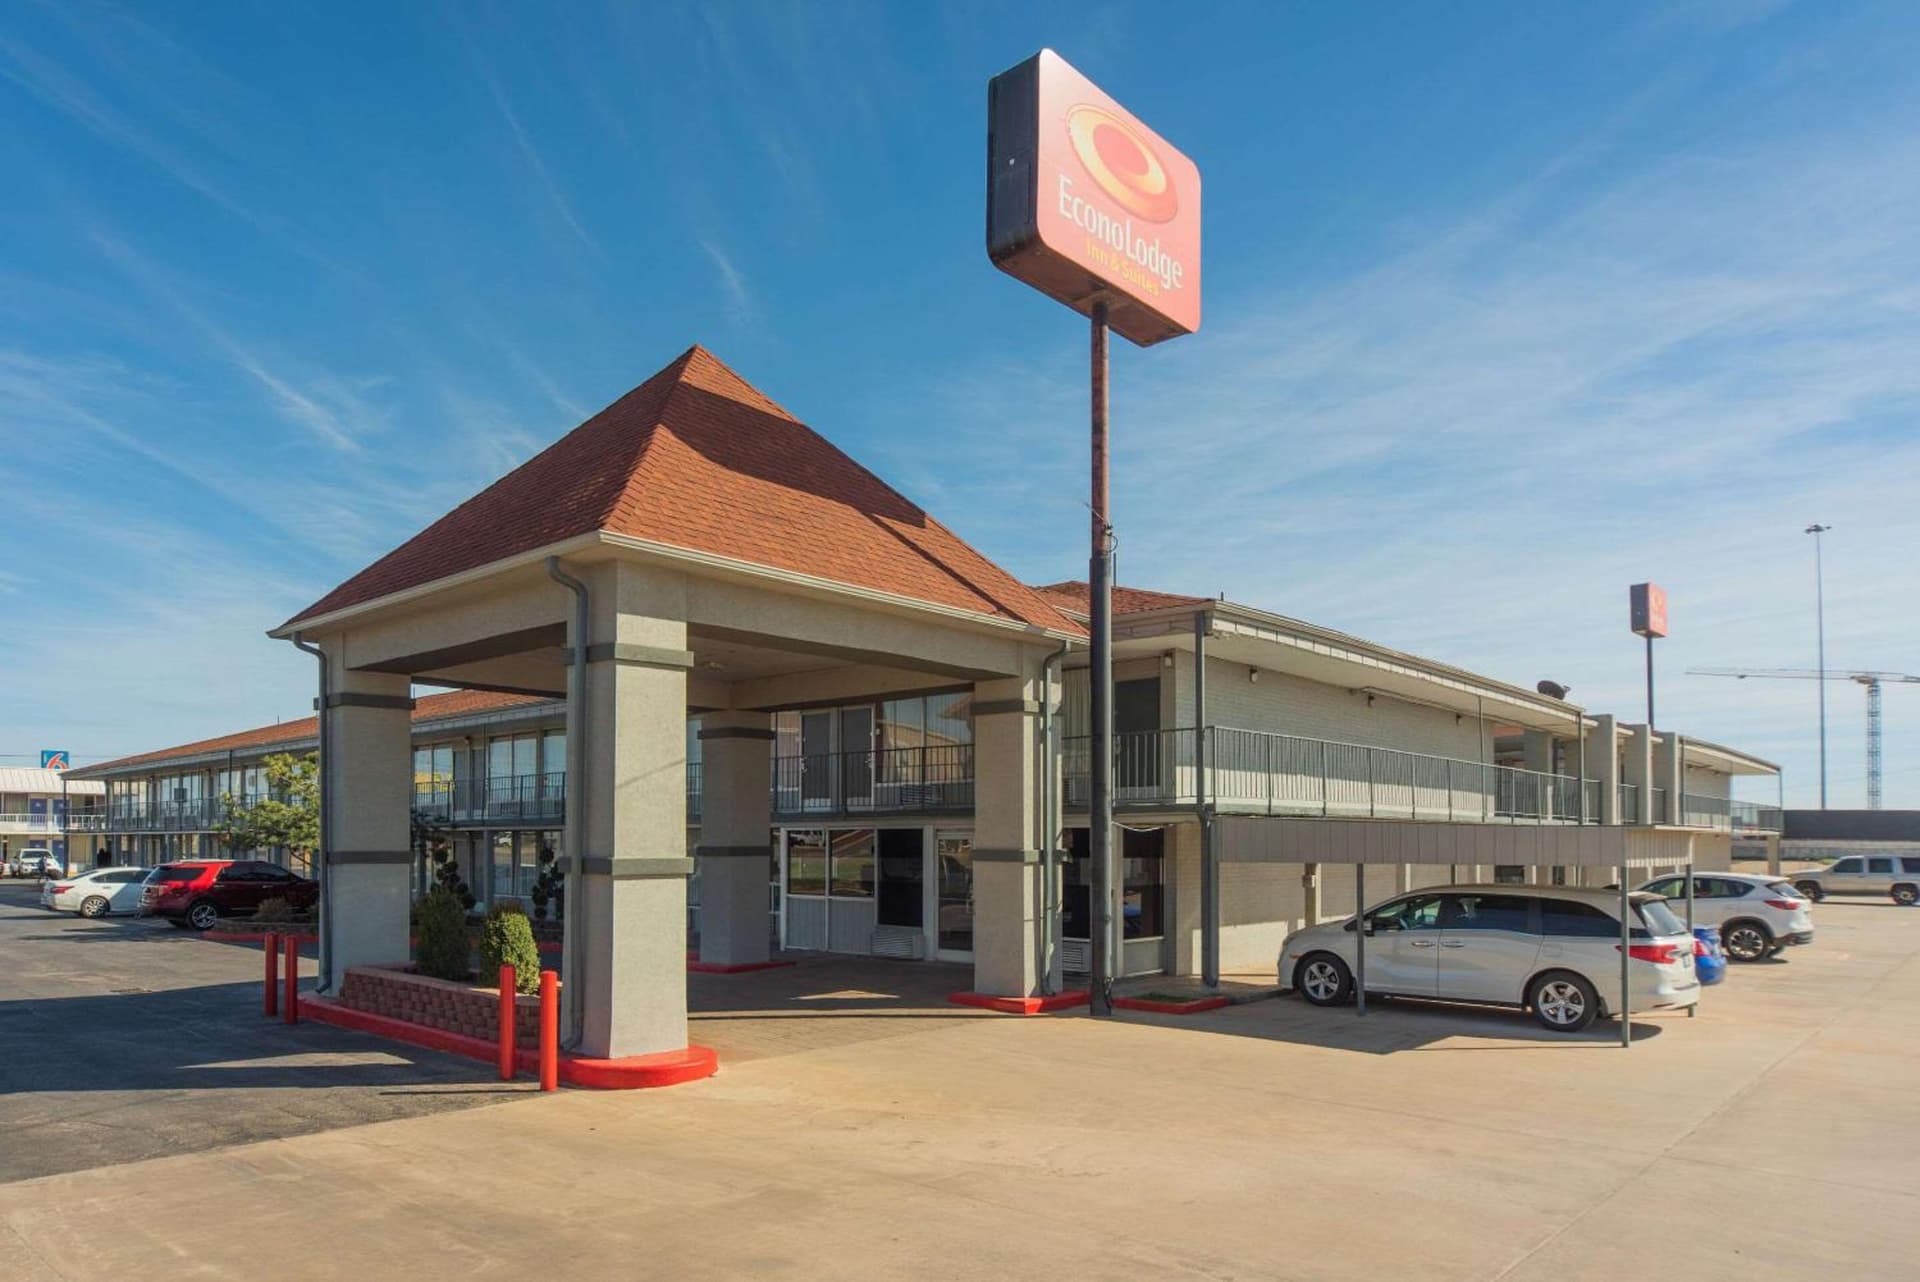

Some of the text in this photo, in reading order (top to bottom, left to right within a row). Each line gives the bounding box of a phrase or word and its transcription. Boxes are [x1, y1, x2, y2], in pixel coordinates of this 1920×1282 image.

[1058, 173, 1184, 290] EconoLodge
[1086, 239, 1160, 297] Inn & Suites
[47, 752, 68, 770] 6
